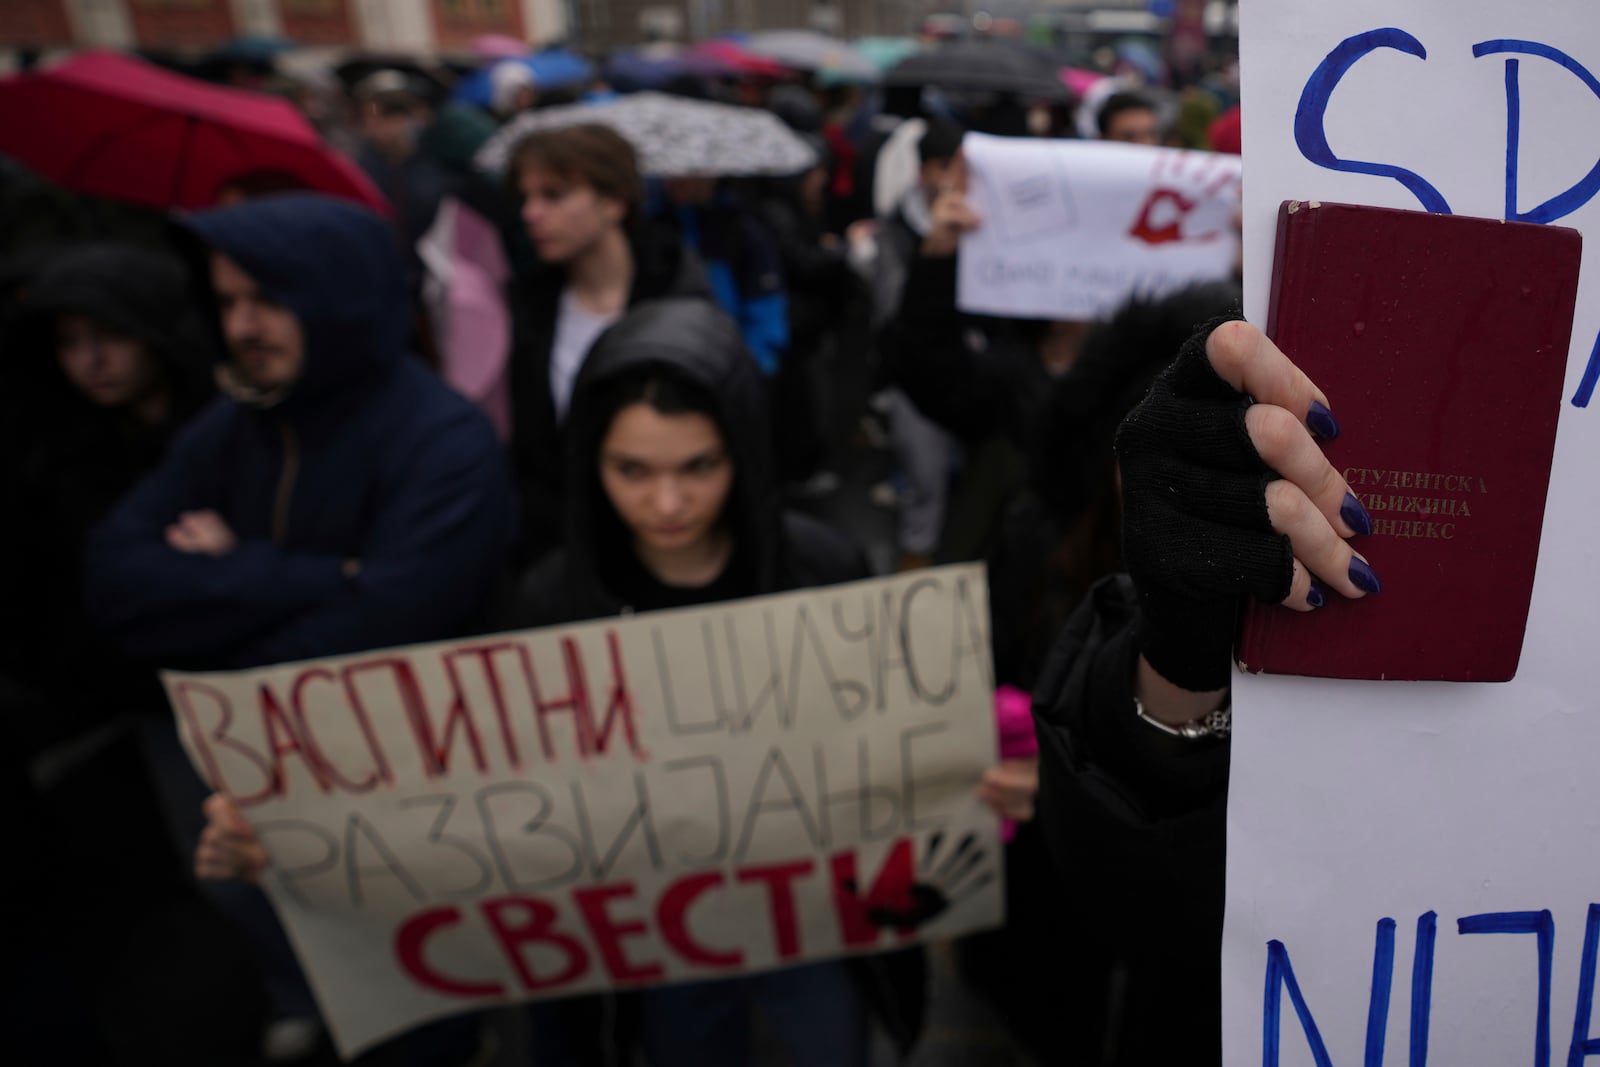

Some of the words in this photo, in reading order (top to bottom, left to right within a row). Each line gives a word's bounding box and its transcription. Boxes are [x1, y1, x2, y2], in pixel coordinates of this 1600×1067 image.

[174, 630, 648, 807] ВАСПИТНИ
[257, 721, 951, 910] РАЗВИЈАЊЕ
[393, 835, 918, 997] СВЕСТИ
